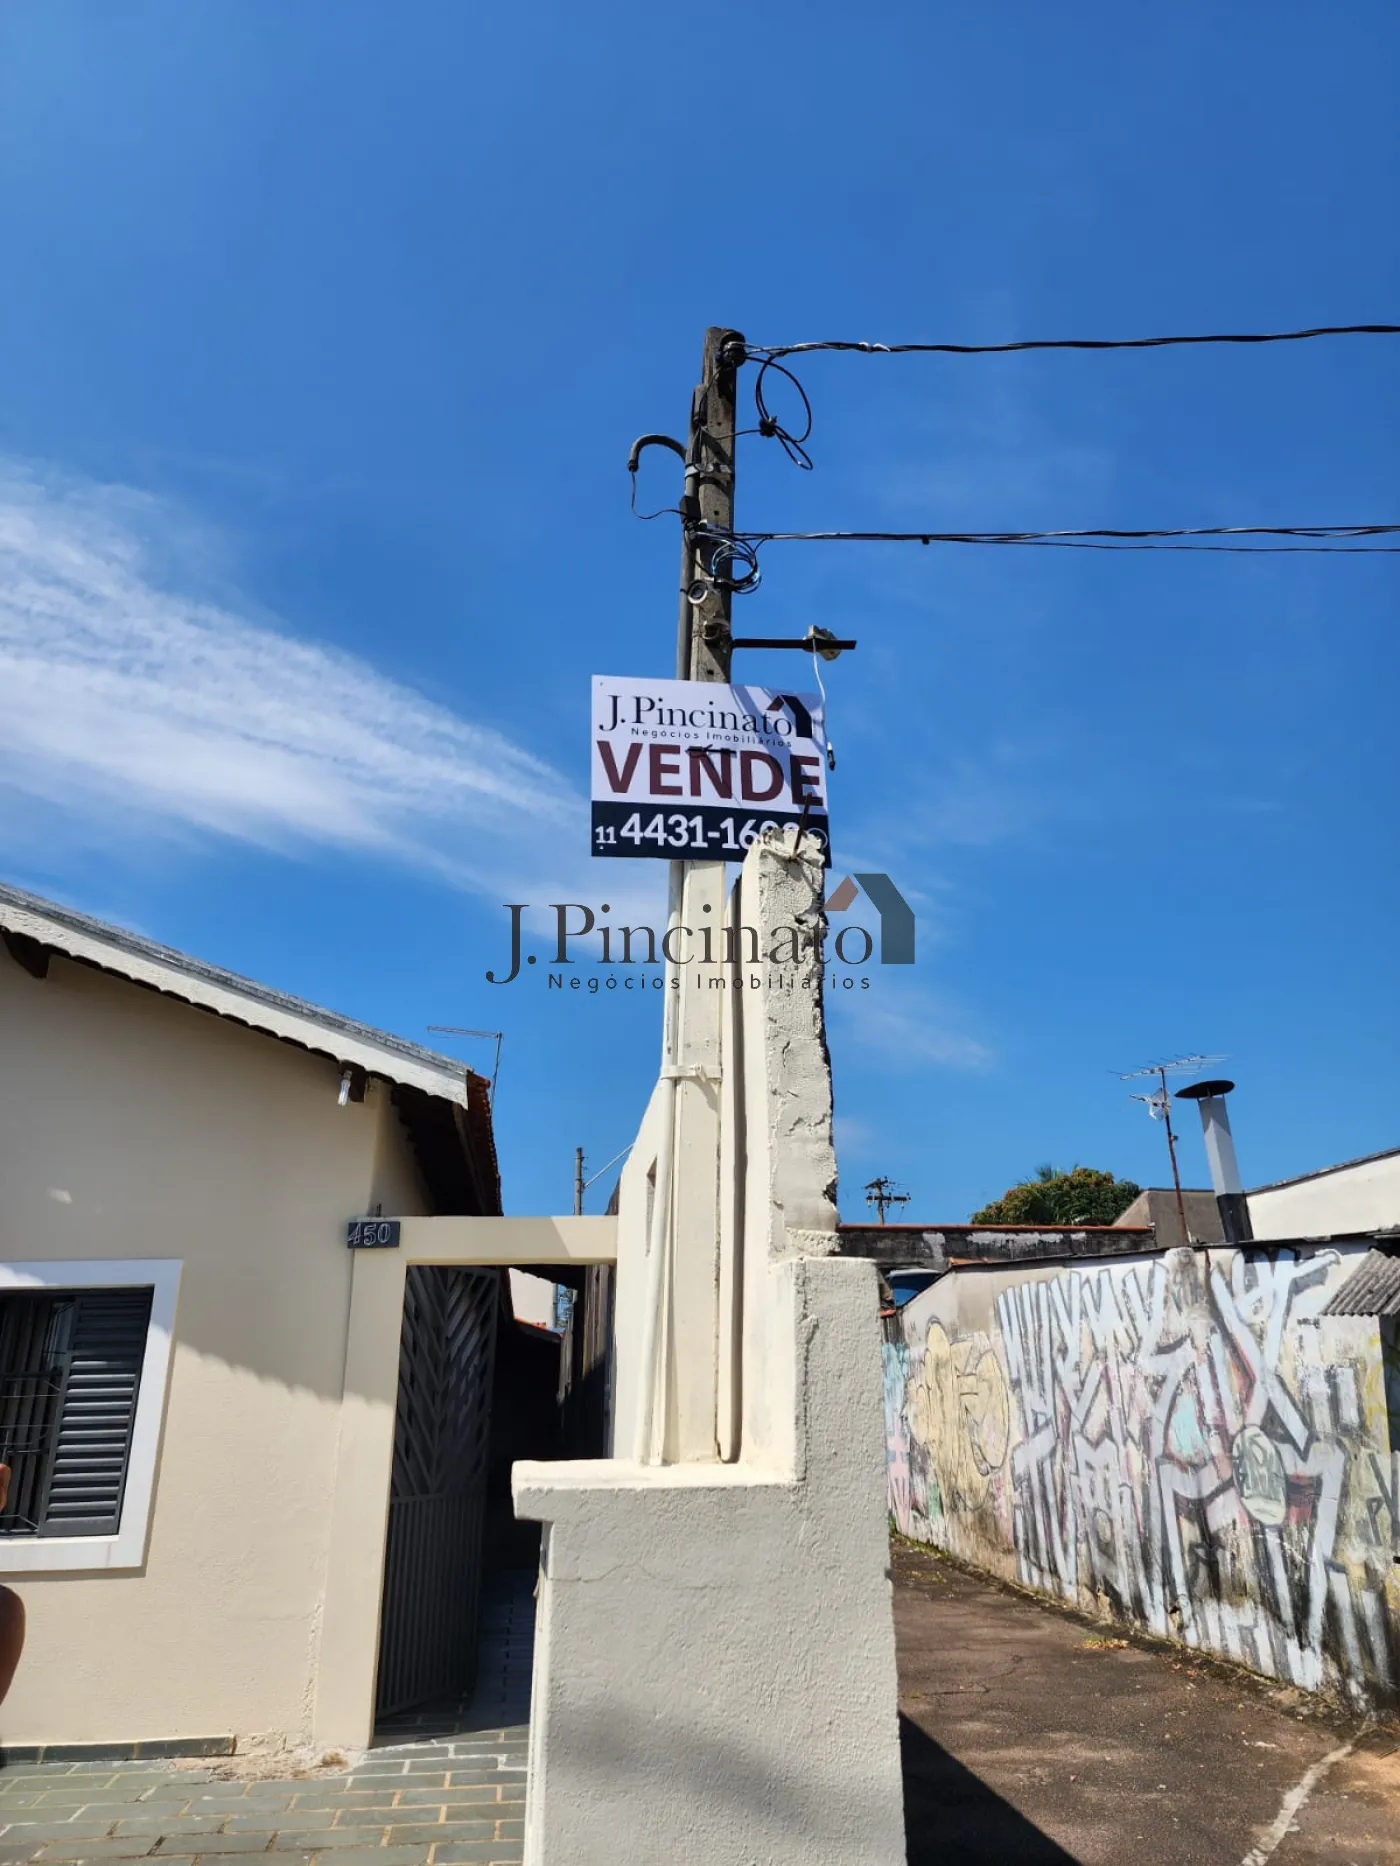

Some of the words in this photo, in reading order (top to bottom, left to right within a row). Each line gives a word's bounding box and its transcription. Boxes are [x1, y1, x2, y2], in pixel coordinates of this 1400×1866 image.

[630, 727, 700, 739] Negócios
[706, 732, 792, 748] Imobiliários
[596, 740, 824, 806] VENDE
[595, 825, 617, 844] 11
[347, 1221, 391, 1246] 450
